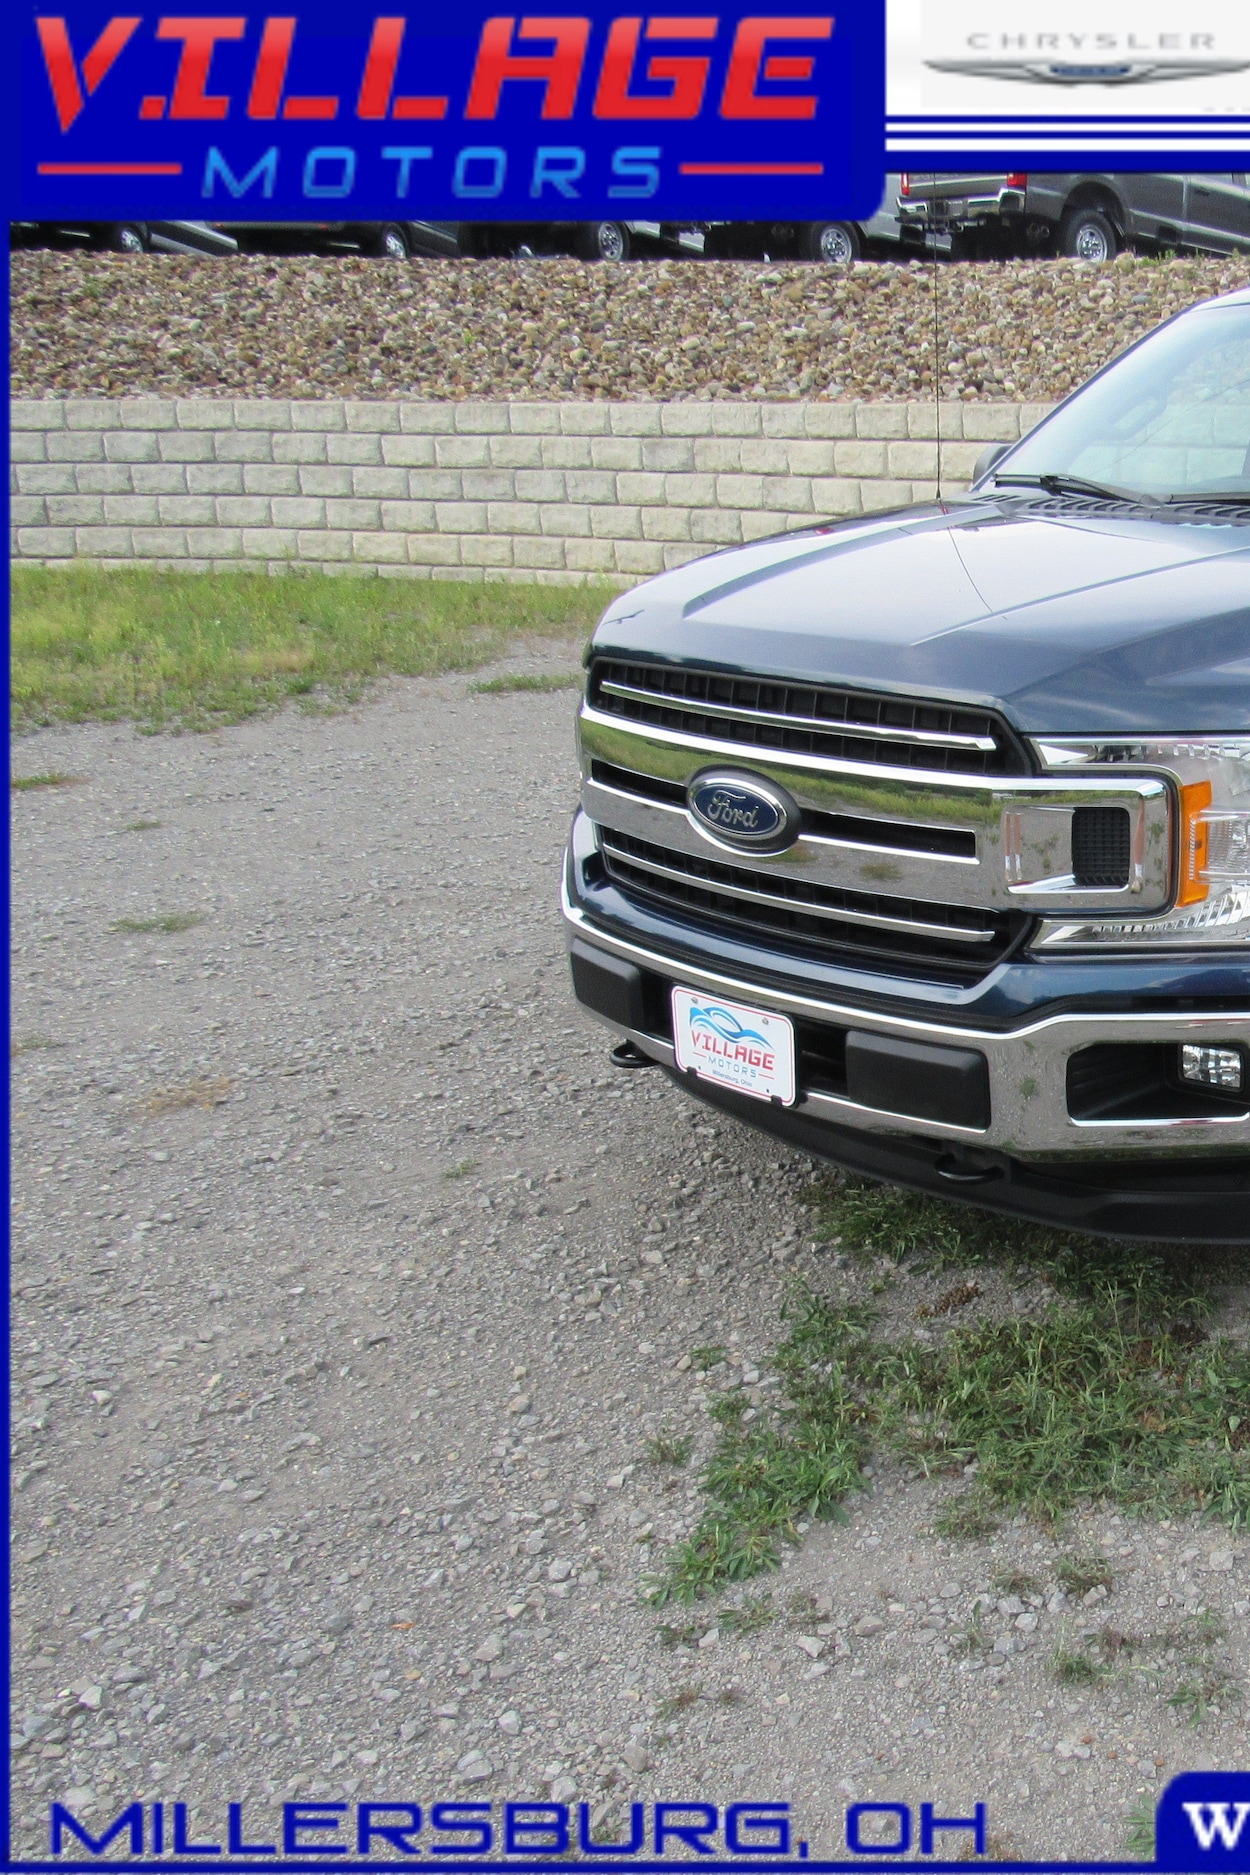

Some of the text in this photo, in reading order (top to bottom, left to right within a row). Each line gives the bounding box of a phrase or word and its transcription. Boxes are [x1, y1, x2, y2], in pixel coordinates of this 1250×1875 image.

[707, 789, 759, 828] Ford
[691, 1030, 775, 1071] VILLAGE
[708, 1056, 757, 1078] MOTORS
